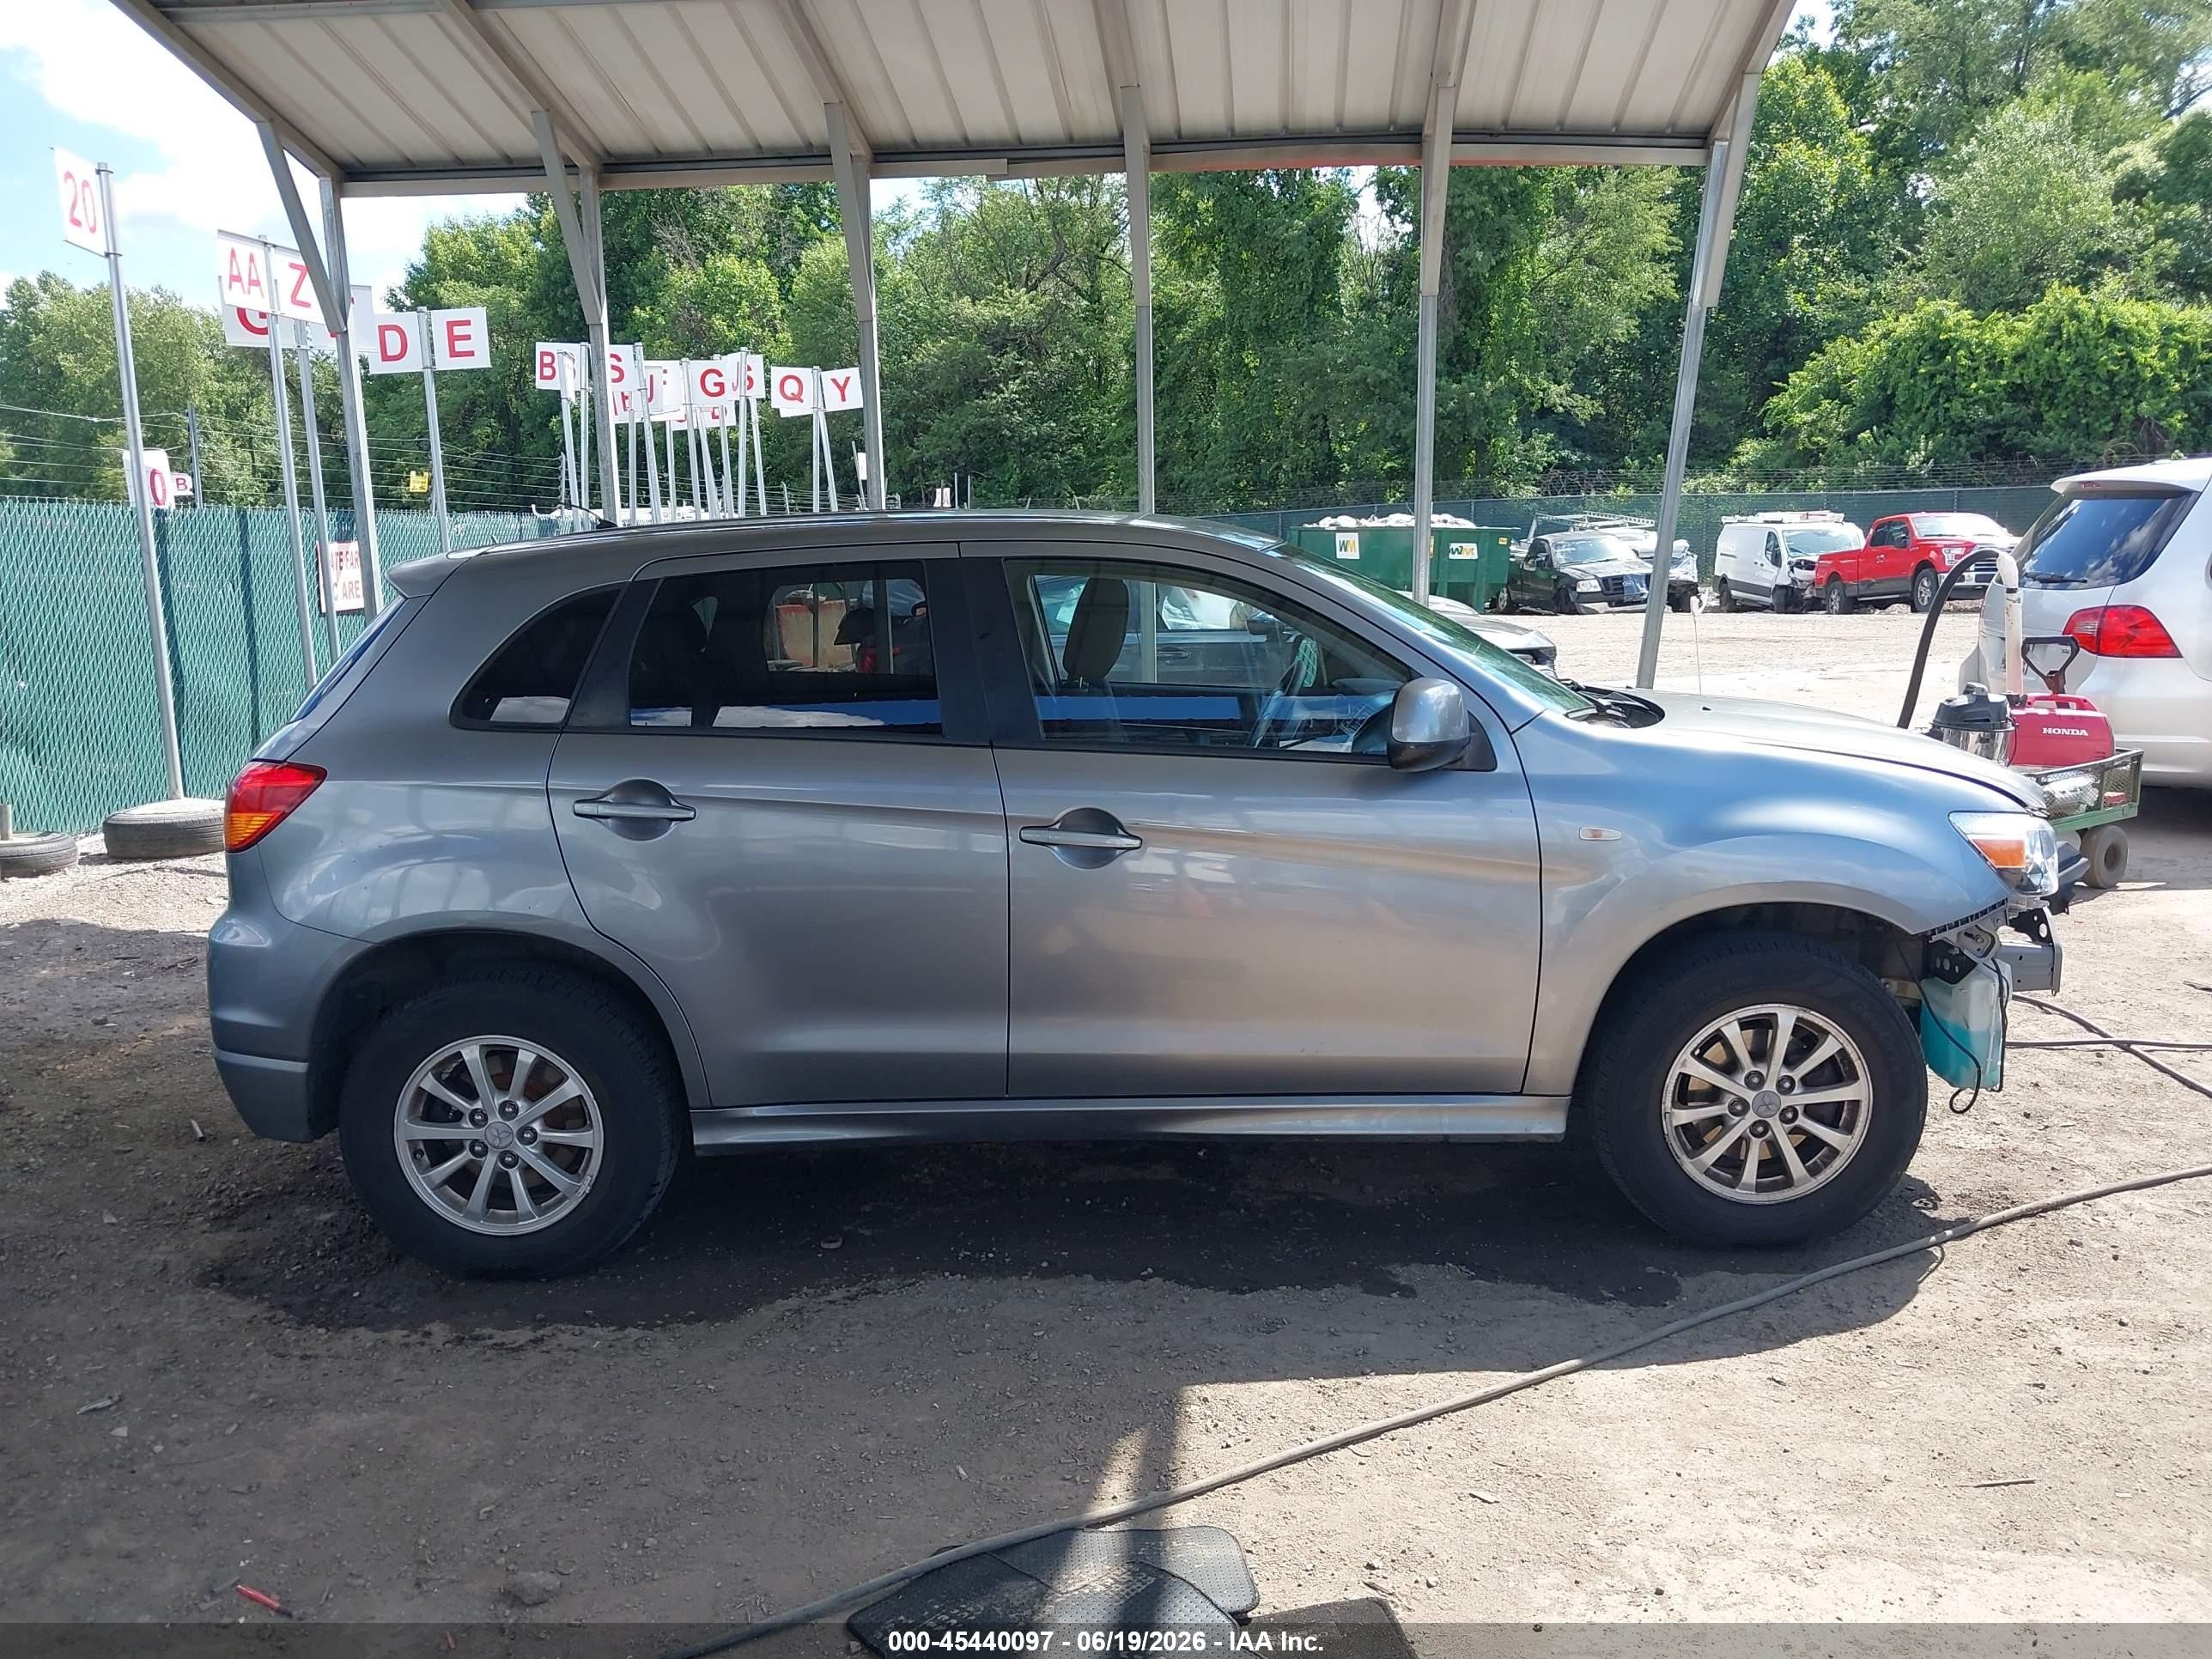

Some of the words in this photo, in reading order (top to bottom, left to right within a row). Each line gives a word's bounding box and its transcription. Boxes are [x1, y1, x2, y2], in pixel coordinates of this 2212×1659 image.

[64, 171, 97, 234] 20
[228, 246, 264, 299] AA
[288, 262, 311, 308] Z
[377, 324, 409, 362] D
[446, 319, 476, 359] E
[539, 350, 556, 380] B
[700, 368, 726, 398] G
[779, 374, 805, 404] Q
[830, 375, 852, 402] Y
[330, 550, 343, 571] ATE
[345, 550, 360, 570] FAR
[1339, 539, 1357, 554] WM
[342, 580, 361, 600] ARE
[2042, 727, 2089, 737] HONDA
